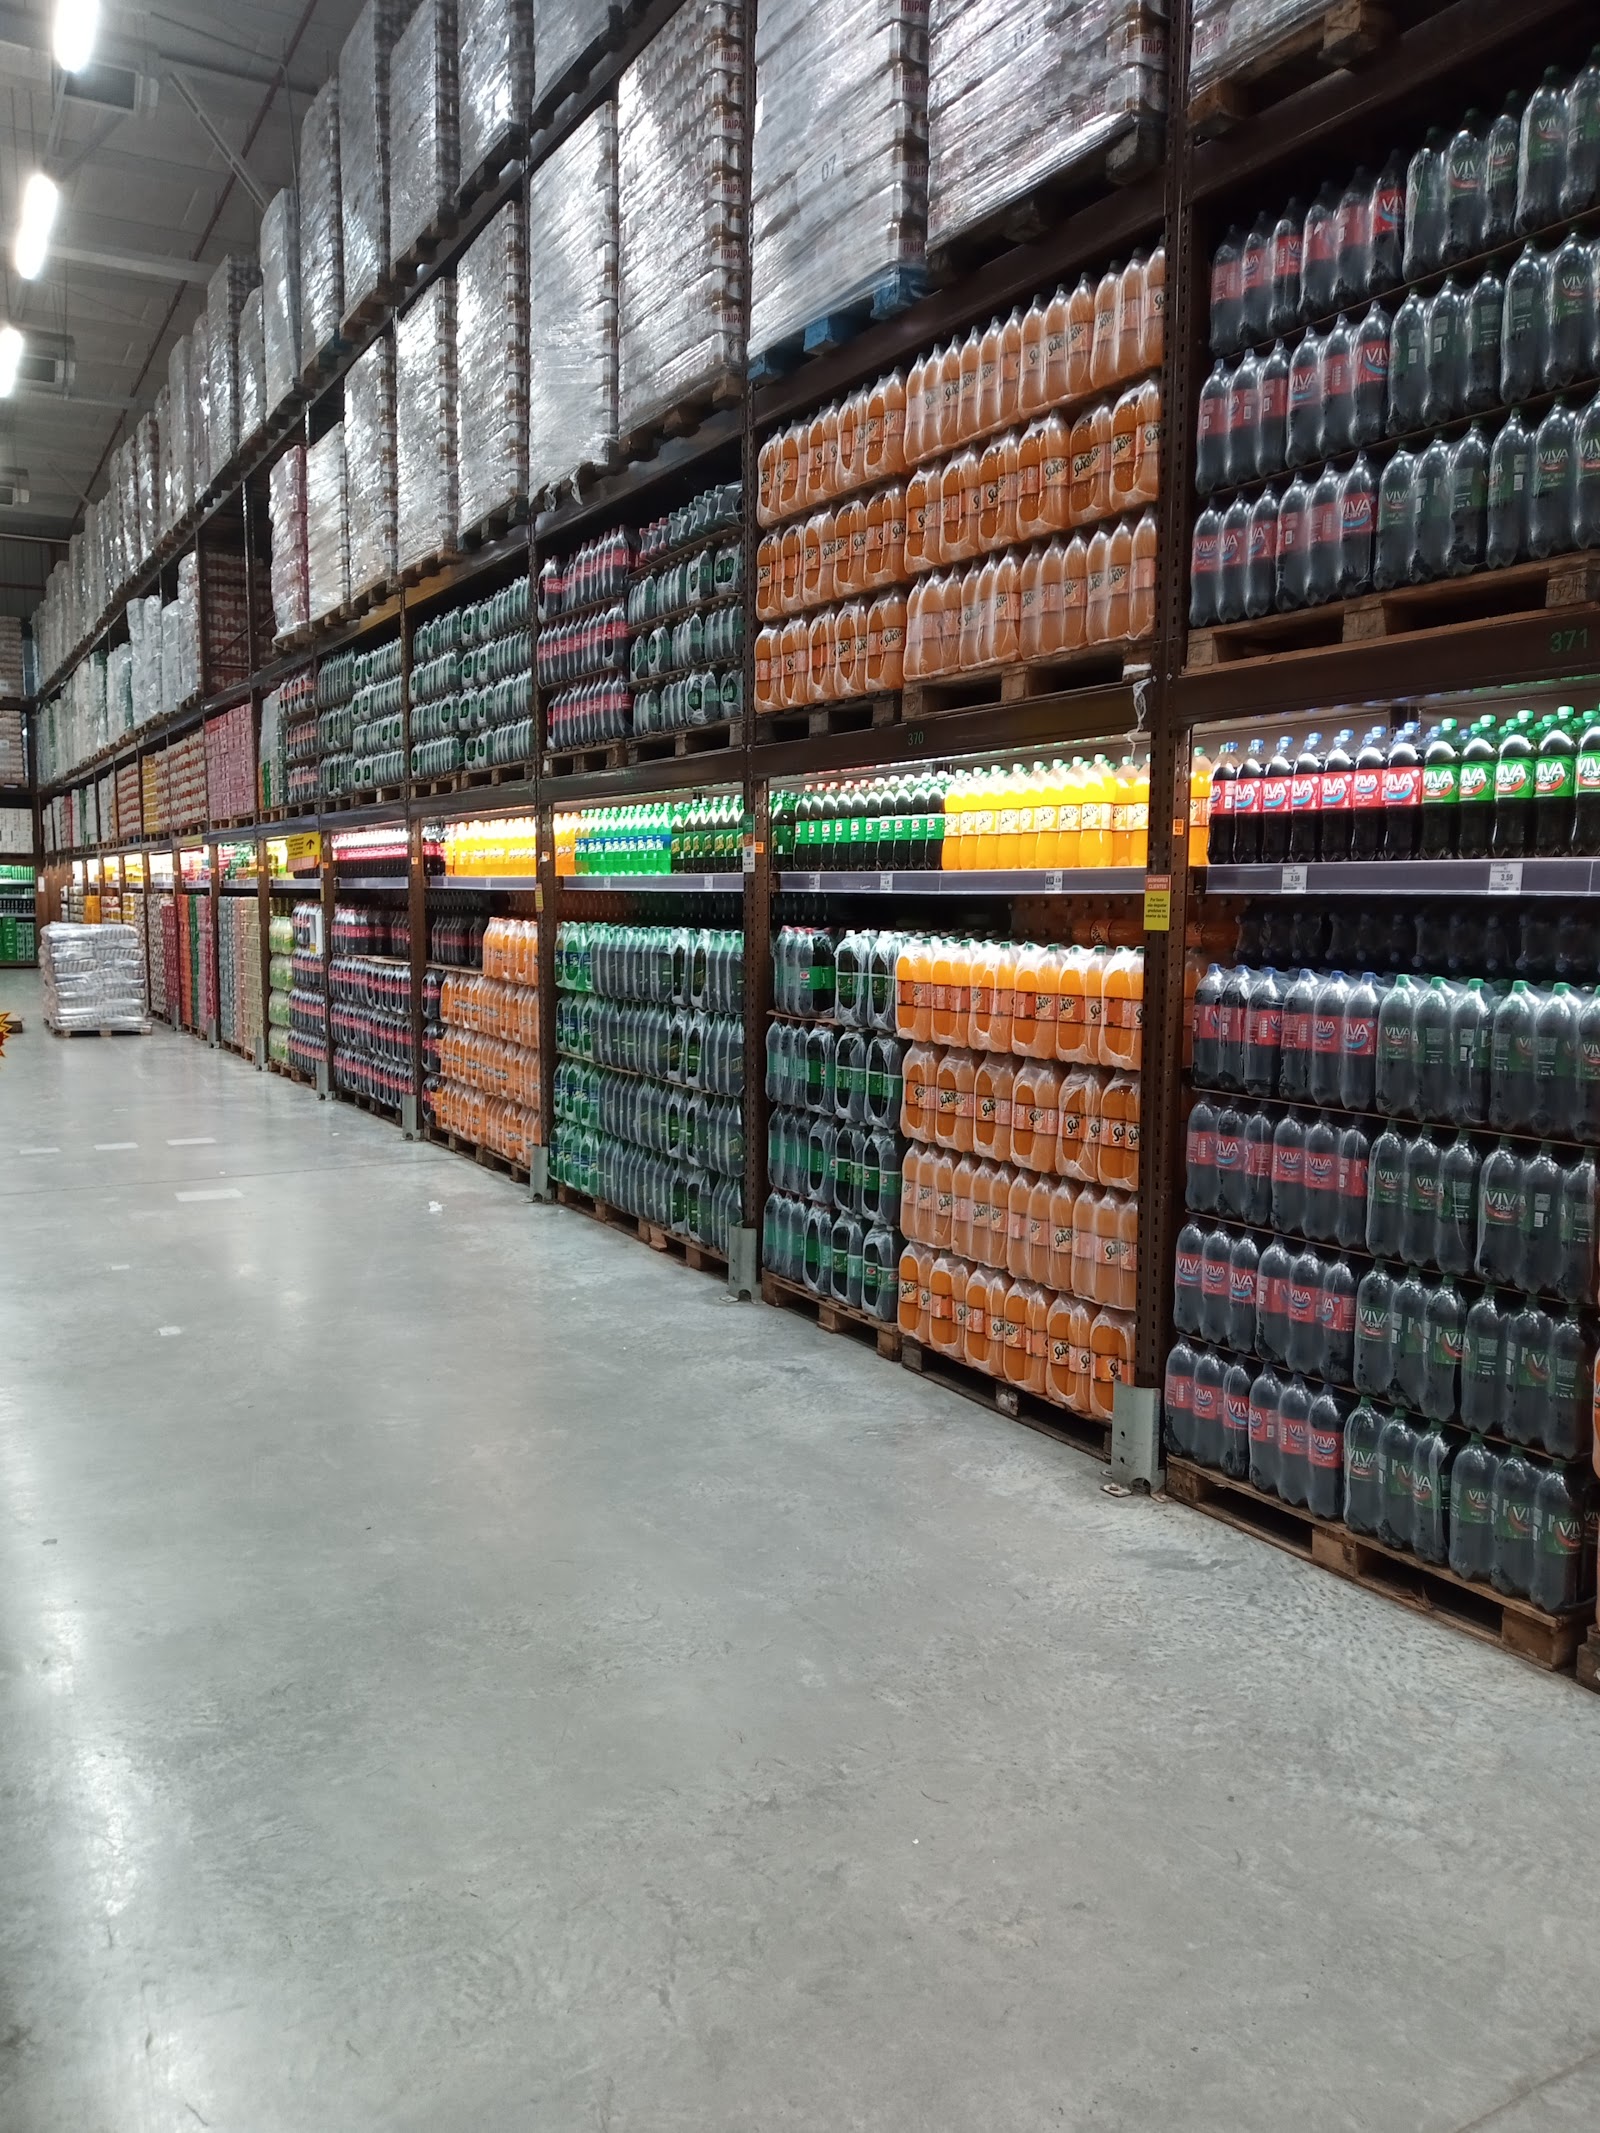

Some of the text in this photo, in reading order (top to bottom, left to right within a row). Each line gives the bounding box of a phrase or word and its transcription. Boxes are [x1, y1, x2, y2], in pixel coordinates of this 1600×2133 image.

[1550, 628, 1588, 653] 371
[907, 731, 924, 746] 370
[1355, 774, 1378, 786] VIVA
[1308, 1157, 1333, 1168] VIVA
[1313, 1434, 1336, 1446] VIVA
